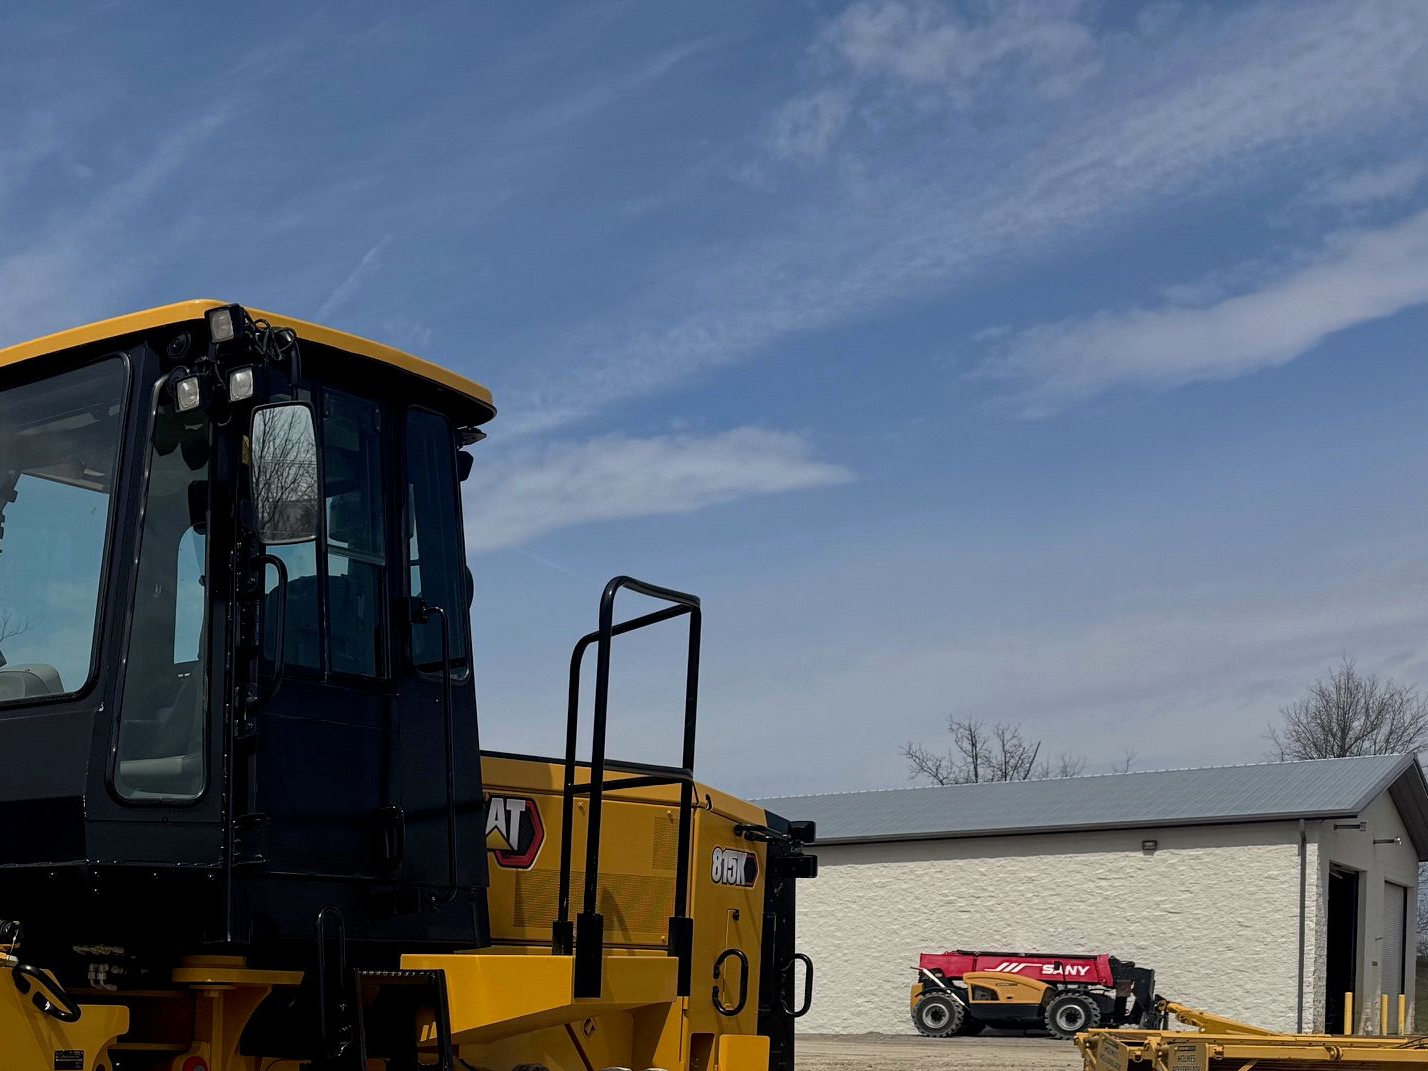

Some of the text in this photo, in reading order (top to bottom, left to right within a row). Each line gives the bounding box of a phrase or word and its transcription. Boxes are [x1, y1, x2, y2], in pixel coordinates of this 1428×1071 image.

[485, 797, 526, 851] AT
[712, 847, 748, 885] 815K
[1042, 964, 1091, 976] SANY
